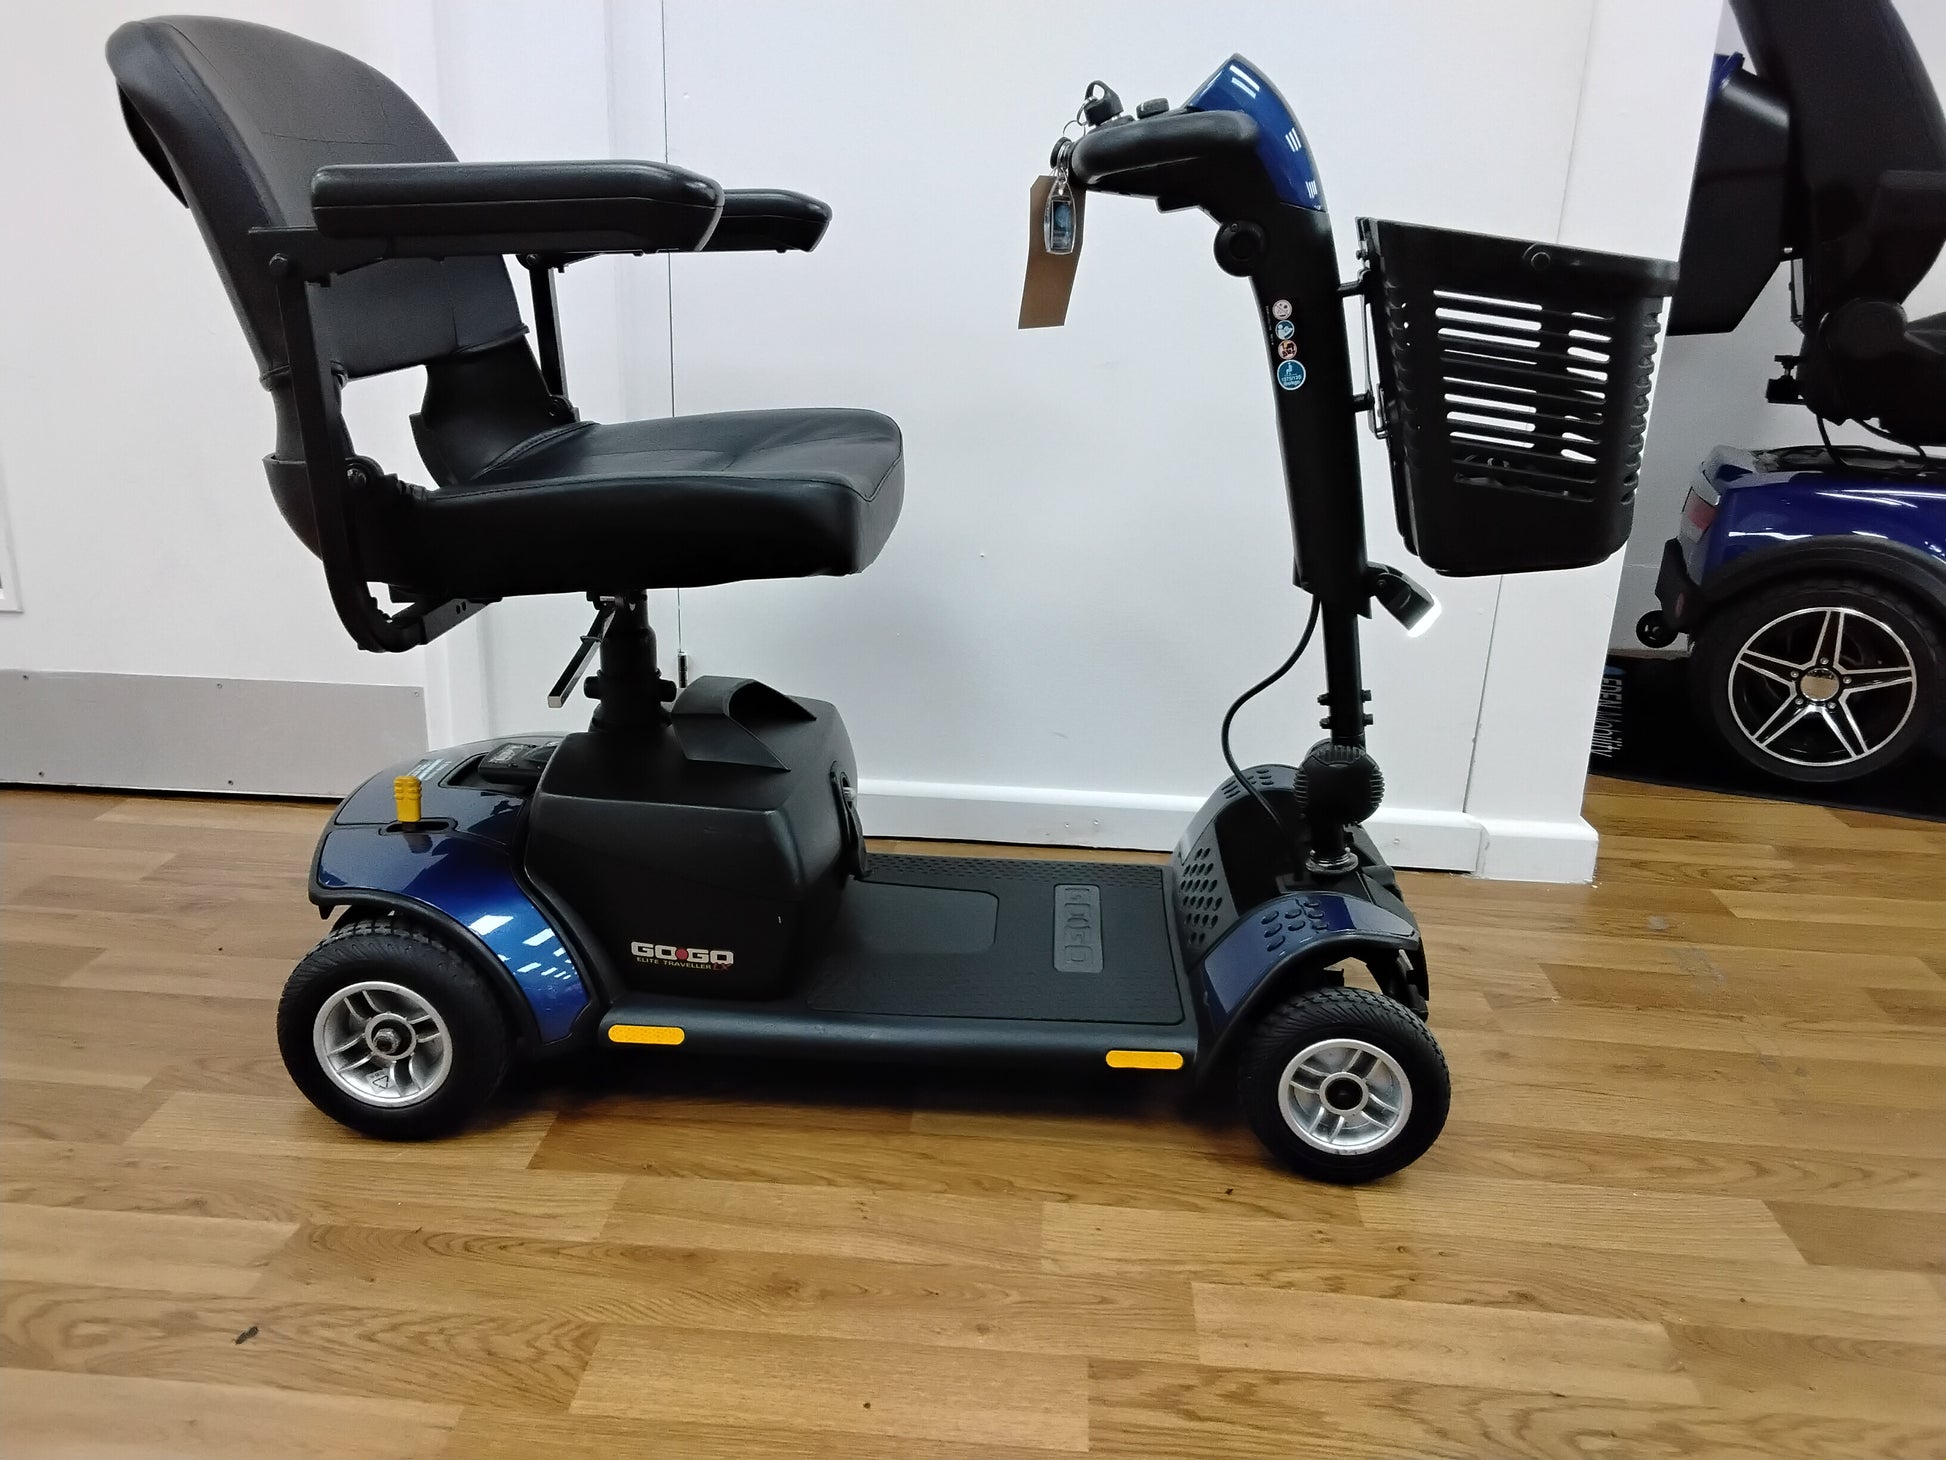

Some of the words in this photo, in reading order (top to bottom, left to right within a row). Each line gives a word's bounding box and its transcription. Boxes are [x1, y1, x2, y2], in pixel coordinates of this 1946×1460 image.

[1598, 677, 1623, 709] EDEN
[1590, 710, 1623, 758] Mobility
[636, 956, 659, 965] ELITE
[663, 960, 712, 970] TRAVELLER
